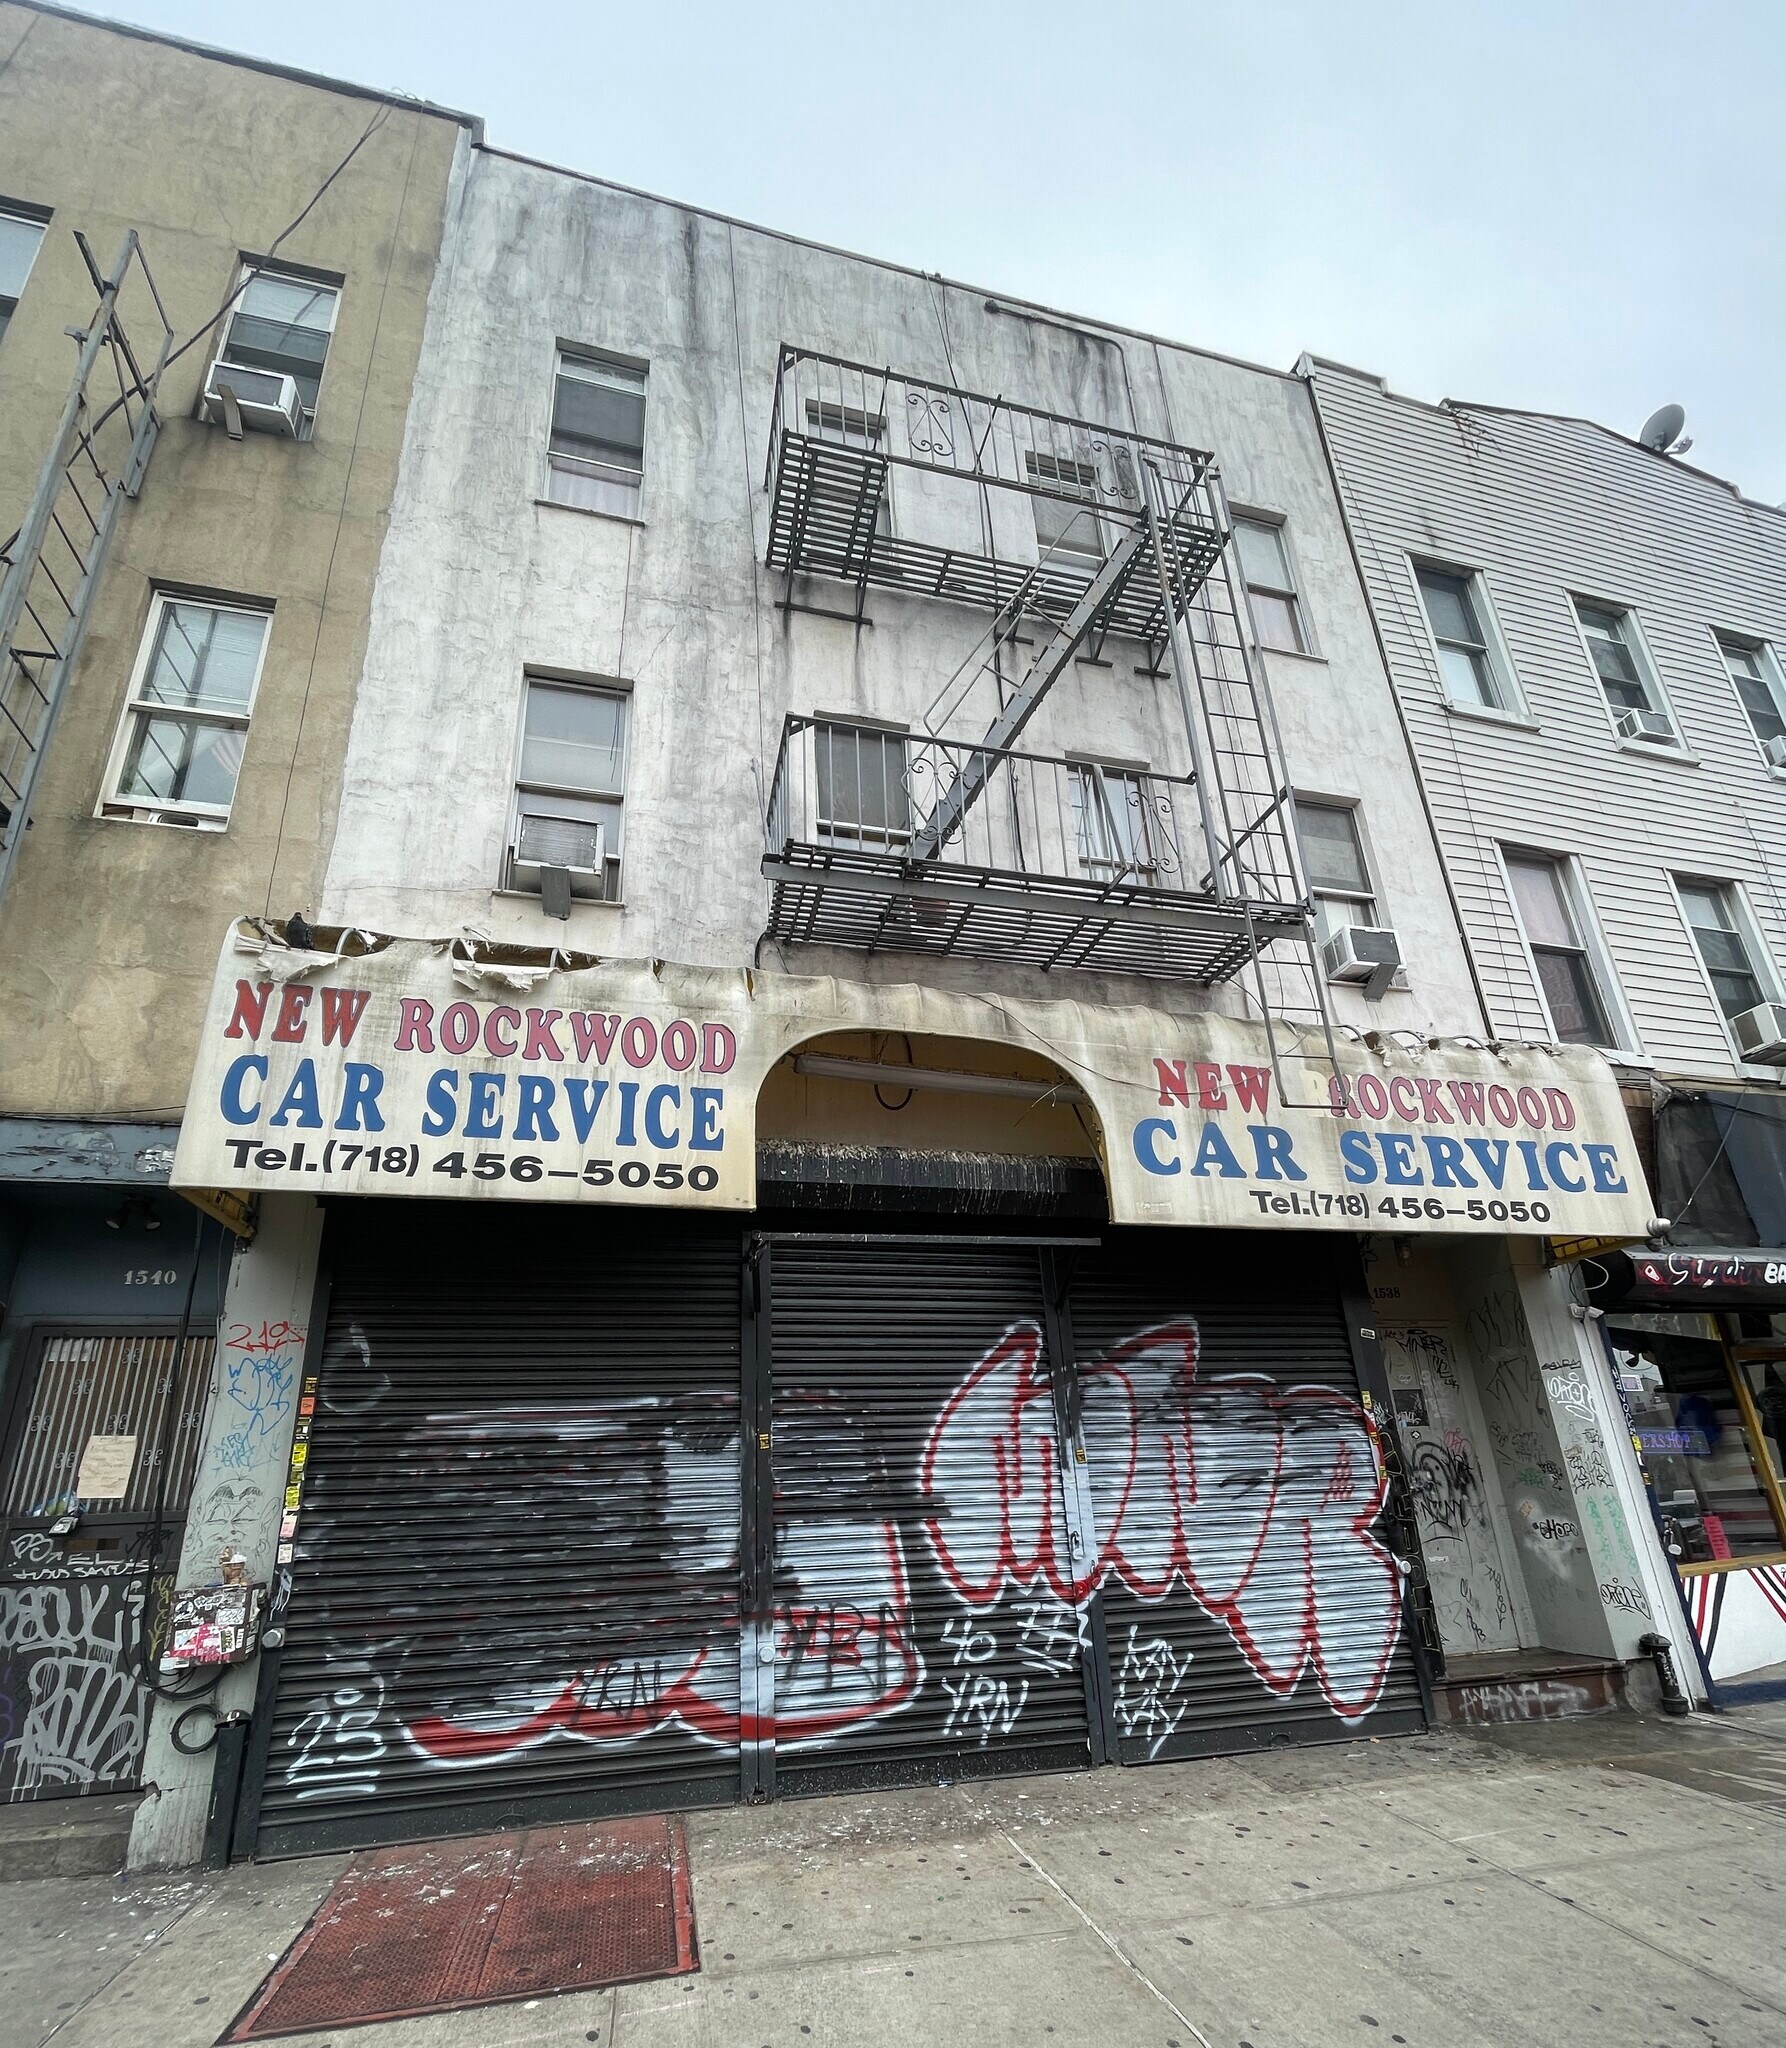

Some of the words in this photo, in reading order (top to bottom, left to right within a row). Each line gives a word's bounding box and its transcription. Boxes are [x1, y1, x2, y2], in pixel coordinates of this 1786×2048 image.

[224, 979, 371, 1048] NEW
[394, 997, 736, 1074] ROCKWOOD
[220, 1054, 387, 1131] CAR
[421, 1069, 725, 1151] SERVICE
[1152, 1058, 1271, 1115] NEW
[1328, 1073, 1576, 1132] ROCKWOOD
[1132, 1118, 1308, 1181] CAR
[1340, 1130, 1628, 1194] SERVICE
[124, 1269, 178, 1285] 1540
[1373, 1286, 1401, 1300] 1538
